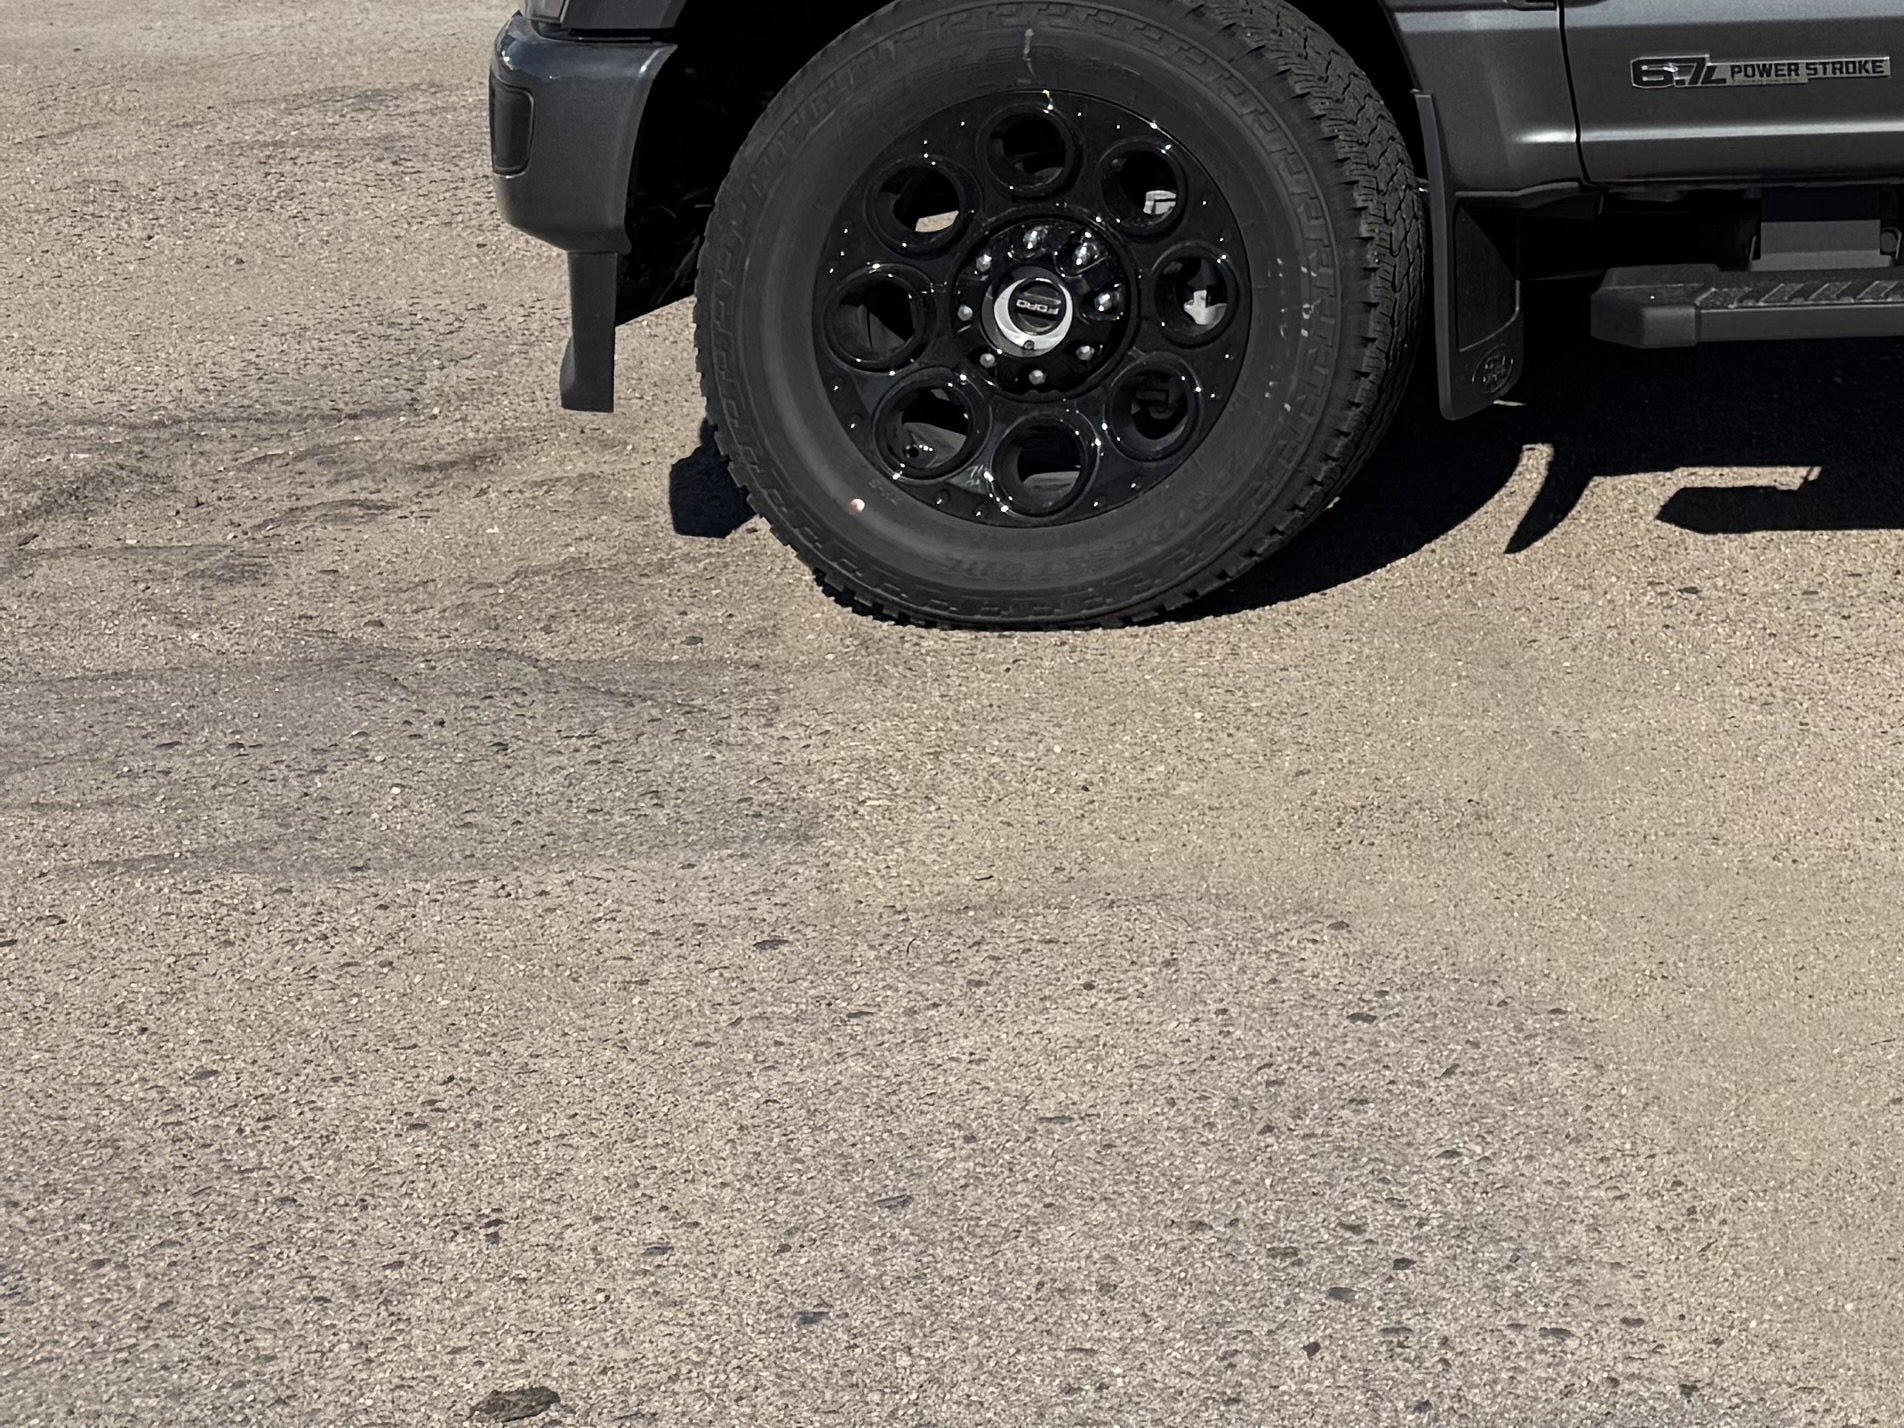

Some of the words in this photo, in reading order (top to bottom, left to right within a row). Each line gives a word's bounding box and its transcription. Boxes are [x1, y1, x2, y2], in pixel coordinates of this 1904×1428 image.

[1630, 54, 1728, 88] 6.7L
[1730, 63, 1800, 79] POWER
[1805, 59, 1886, 76] STROKE
[1015, 298, 1061, 315] FORD
